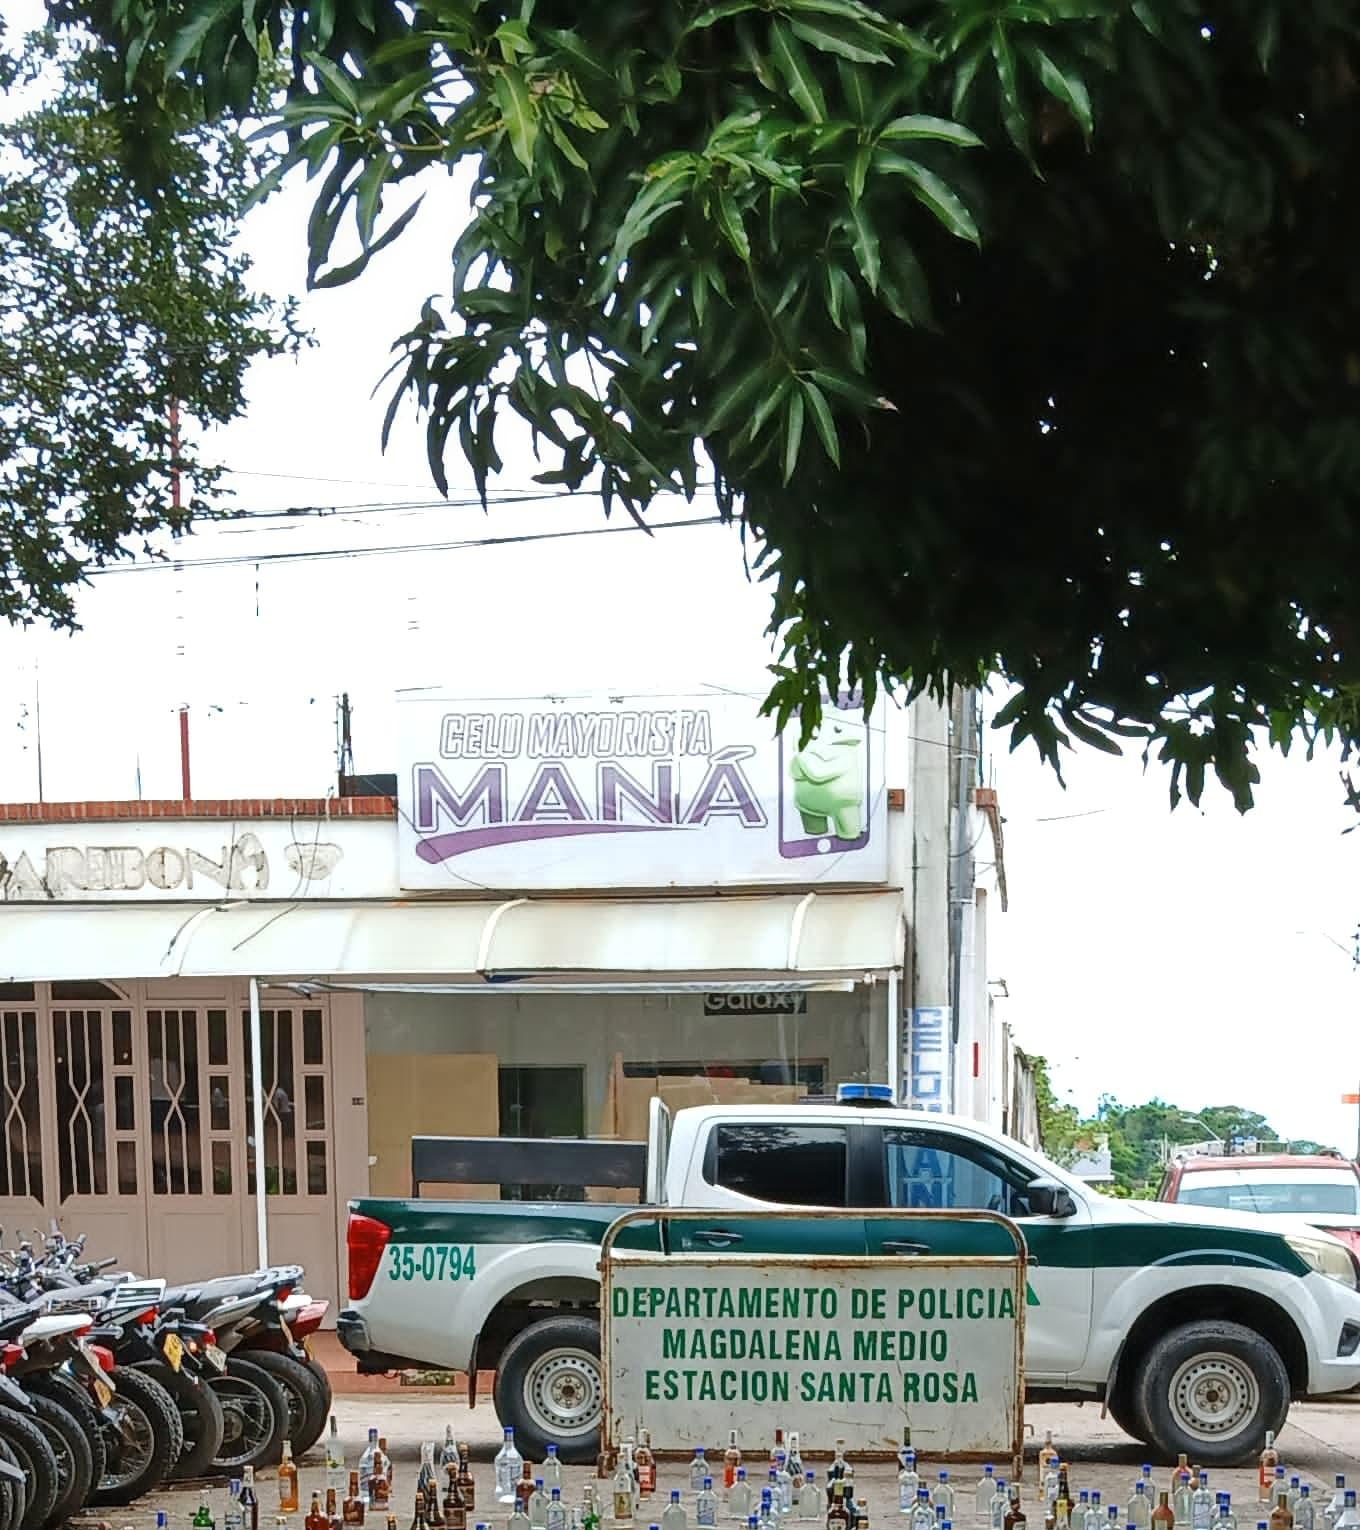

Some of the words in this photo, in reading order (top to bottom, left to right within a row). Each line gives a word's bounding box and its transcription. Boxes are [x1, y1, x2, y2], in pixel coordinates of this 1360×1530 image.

[441, 712, 524, 759] CELU
[527, 710, 712, 759] MAYORISTA
[412, 746, 768, 832] MANÁ
[706, 992, 804, 1013] Galaxy
[613, 1287, 839, 1319] DEPARTAMENTO
[851, 1288, 887, 1319] DE
[897, 1288, 1016, 1319] POLICIA
[662, 1329, 840, 1361] MAGDALENA
[852, 1329, 948, 1362] MEDIO
[645, 1370, 789, 1402] ESTACION
[799, 1371, 892, 1403] SANTA
[902, 1371, 979, 1404] ROSA
